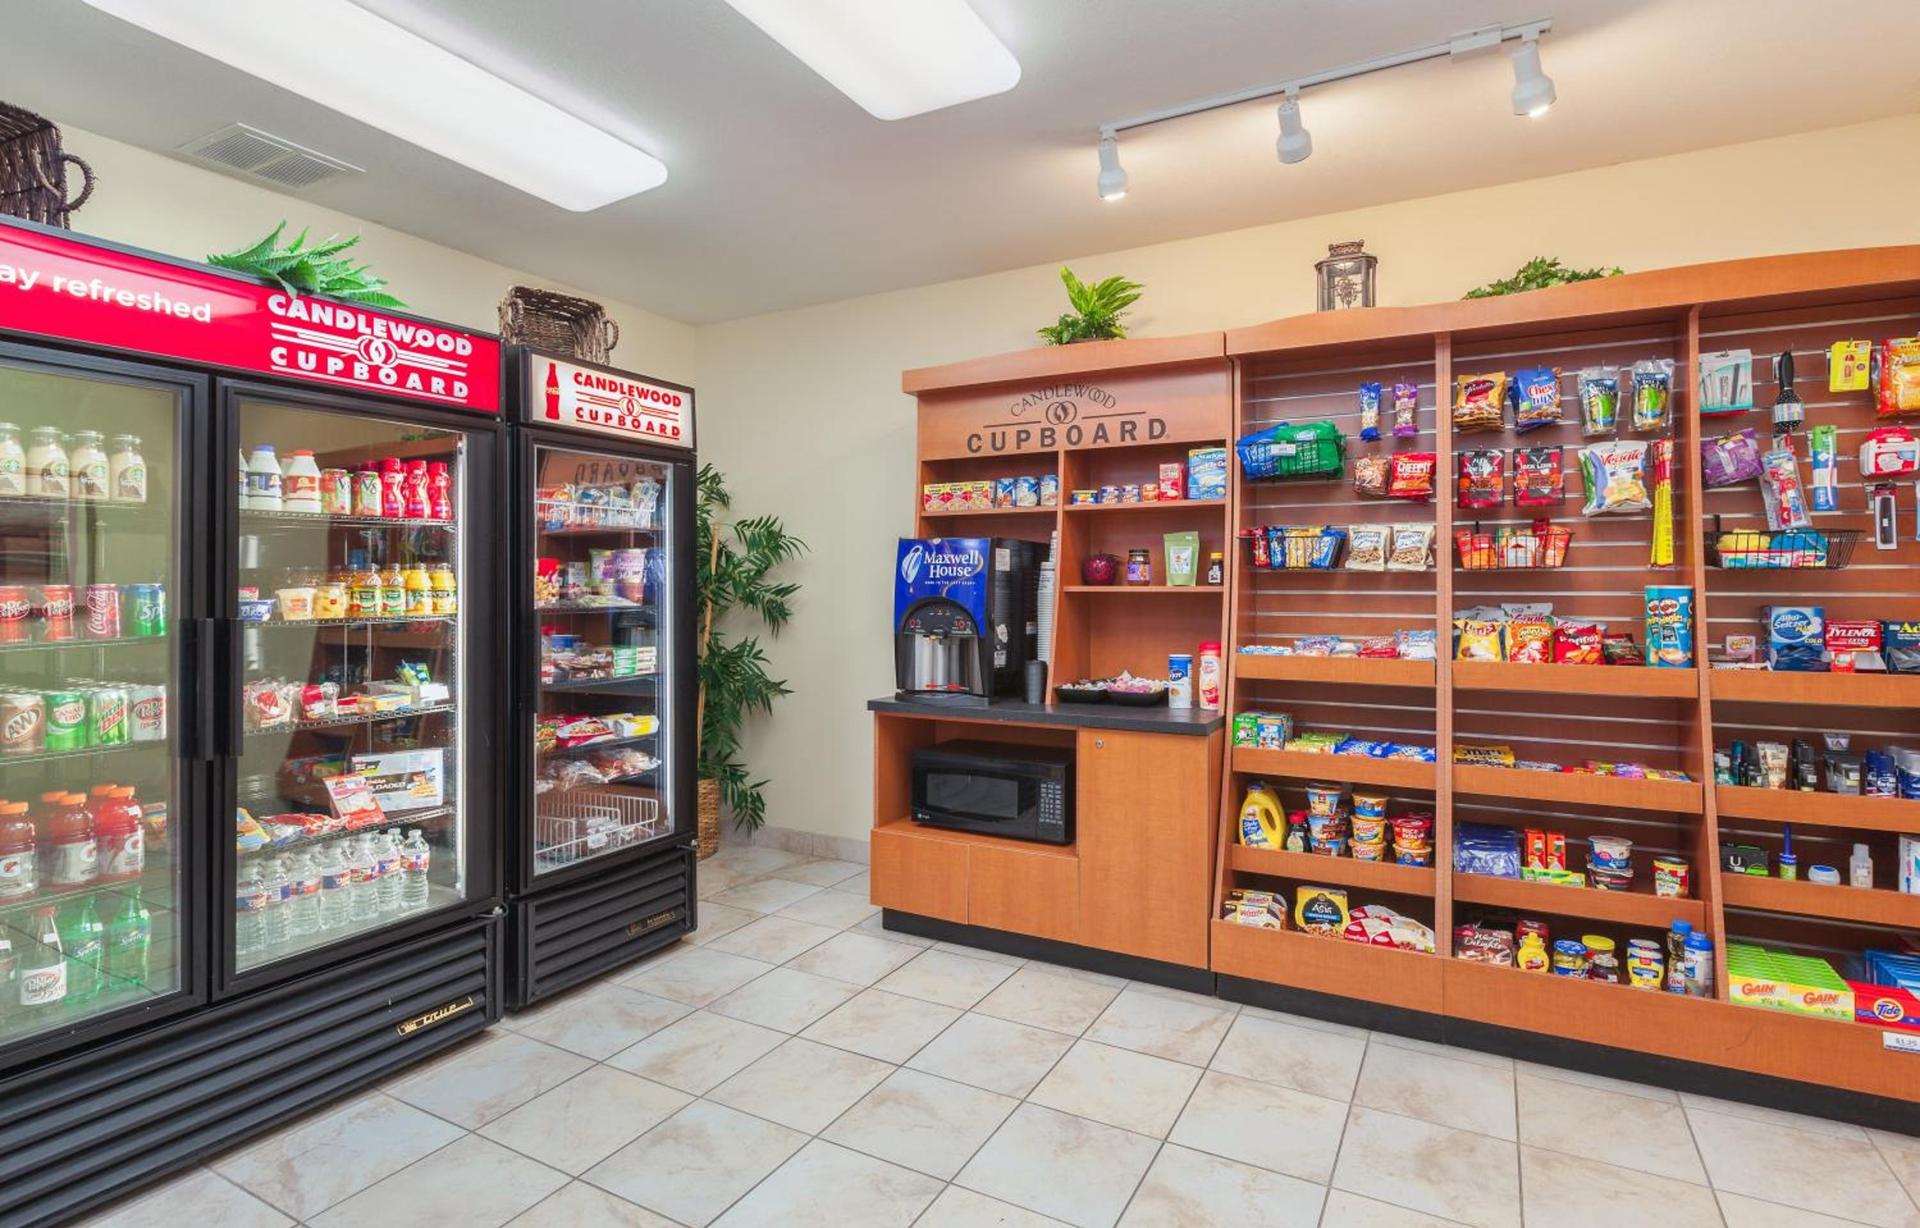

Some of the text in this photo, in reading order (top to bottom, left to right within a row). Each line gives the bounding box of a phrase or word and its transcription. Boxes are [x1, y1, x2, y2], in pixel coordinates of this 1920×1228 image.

[52, 275, 211, 323] refreshed
[267, 294, 473, 357] CANDLEWOOD
[269, 346, 470, 399] CUPBOARD
[573, 372, 682, 407] CANDLEWOOD
[1010, 384, 1117, 417] CANDLEWOOD
[575, 407, 680, 437] CUPBOARD
[966, 418, 1167, 454] CUPBOARD
[924, 550, 979, 565] Maxwell
[929, 565, 972, 578] House
[1828, 628, 1878, 638] TYLENOL
[1741, 982, 1776, 996] GAIN
[1803, 991, 1840, 1006] GAIN
[1876, 1003, 1902, 1016] Tide
